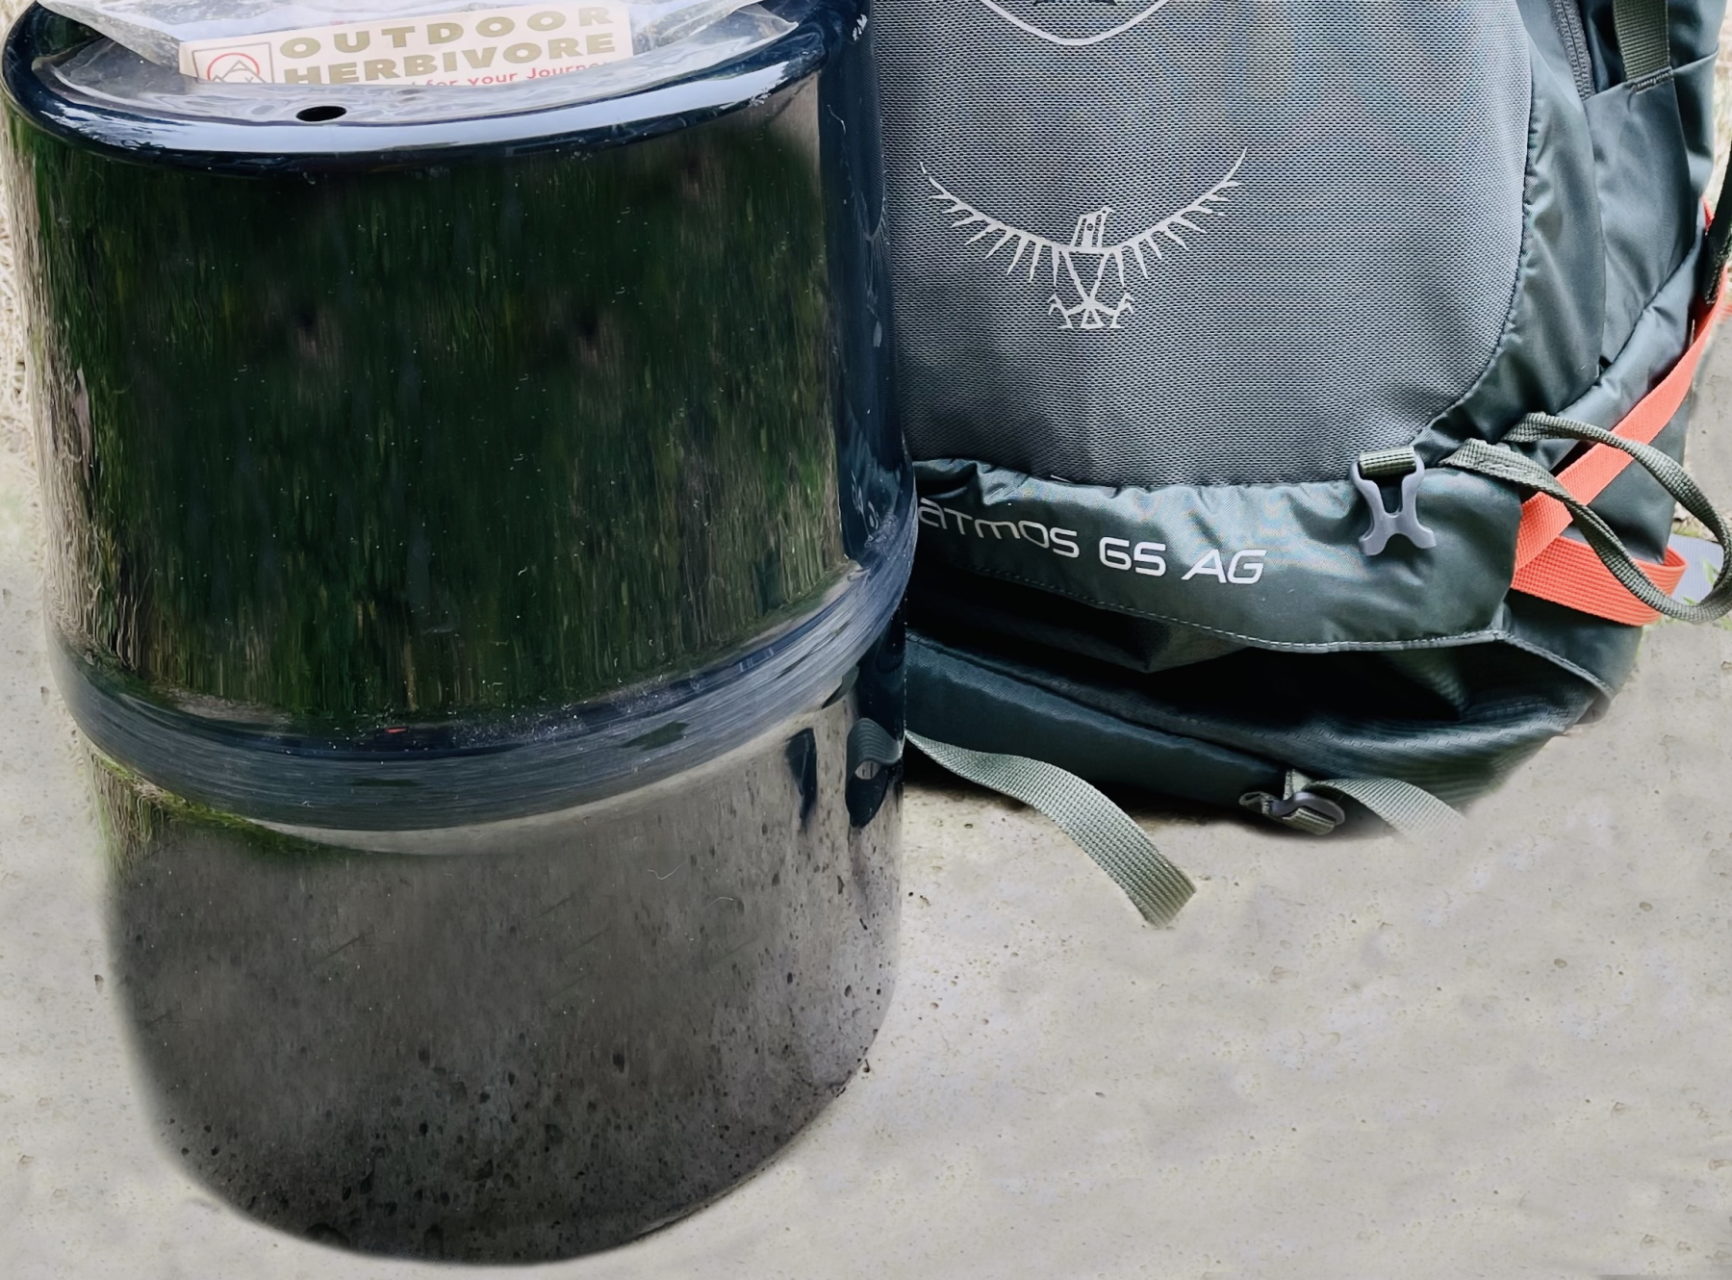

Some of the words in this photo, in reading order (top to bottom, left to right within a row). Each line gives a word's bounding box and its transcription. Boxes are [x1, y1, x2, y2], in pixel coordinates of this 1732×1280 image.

[279, 5, 614, 58] OUTDOOR
[284, 32, 617, 85] HERBIVORE
[1100, 536, 1166, 577] 65
[1181, 549, 1266, 584] AG
